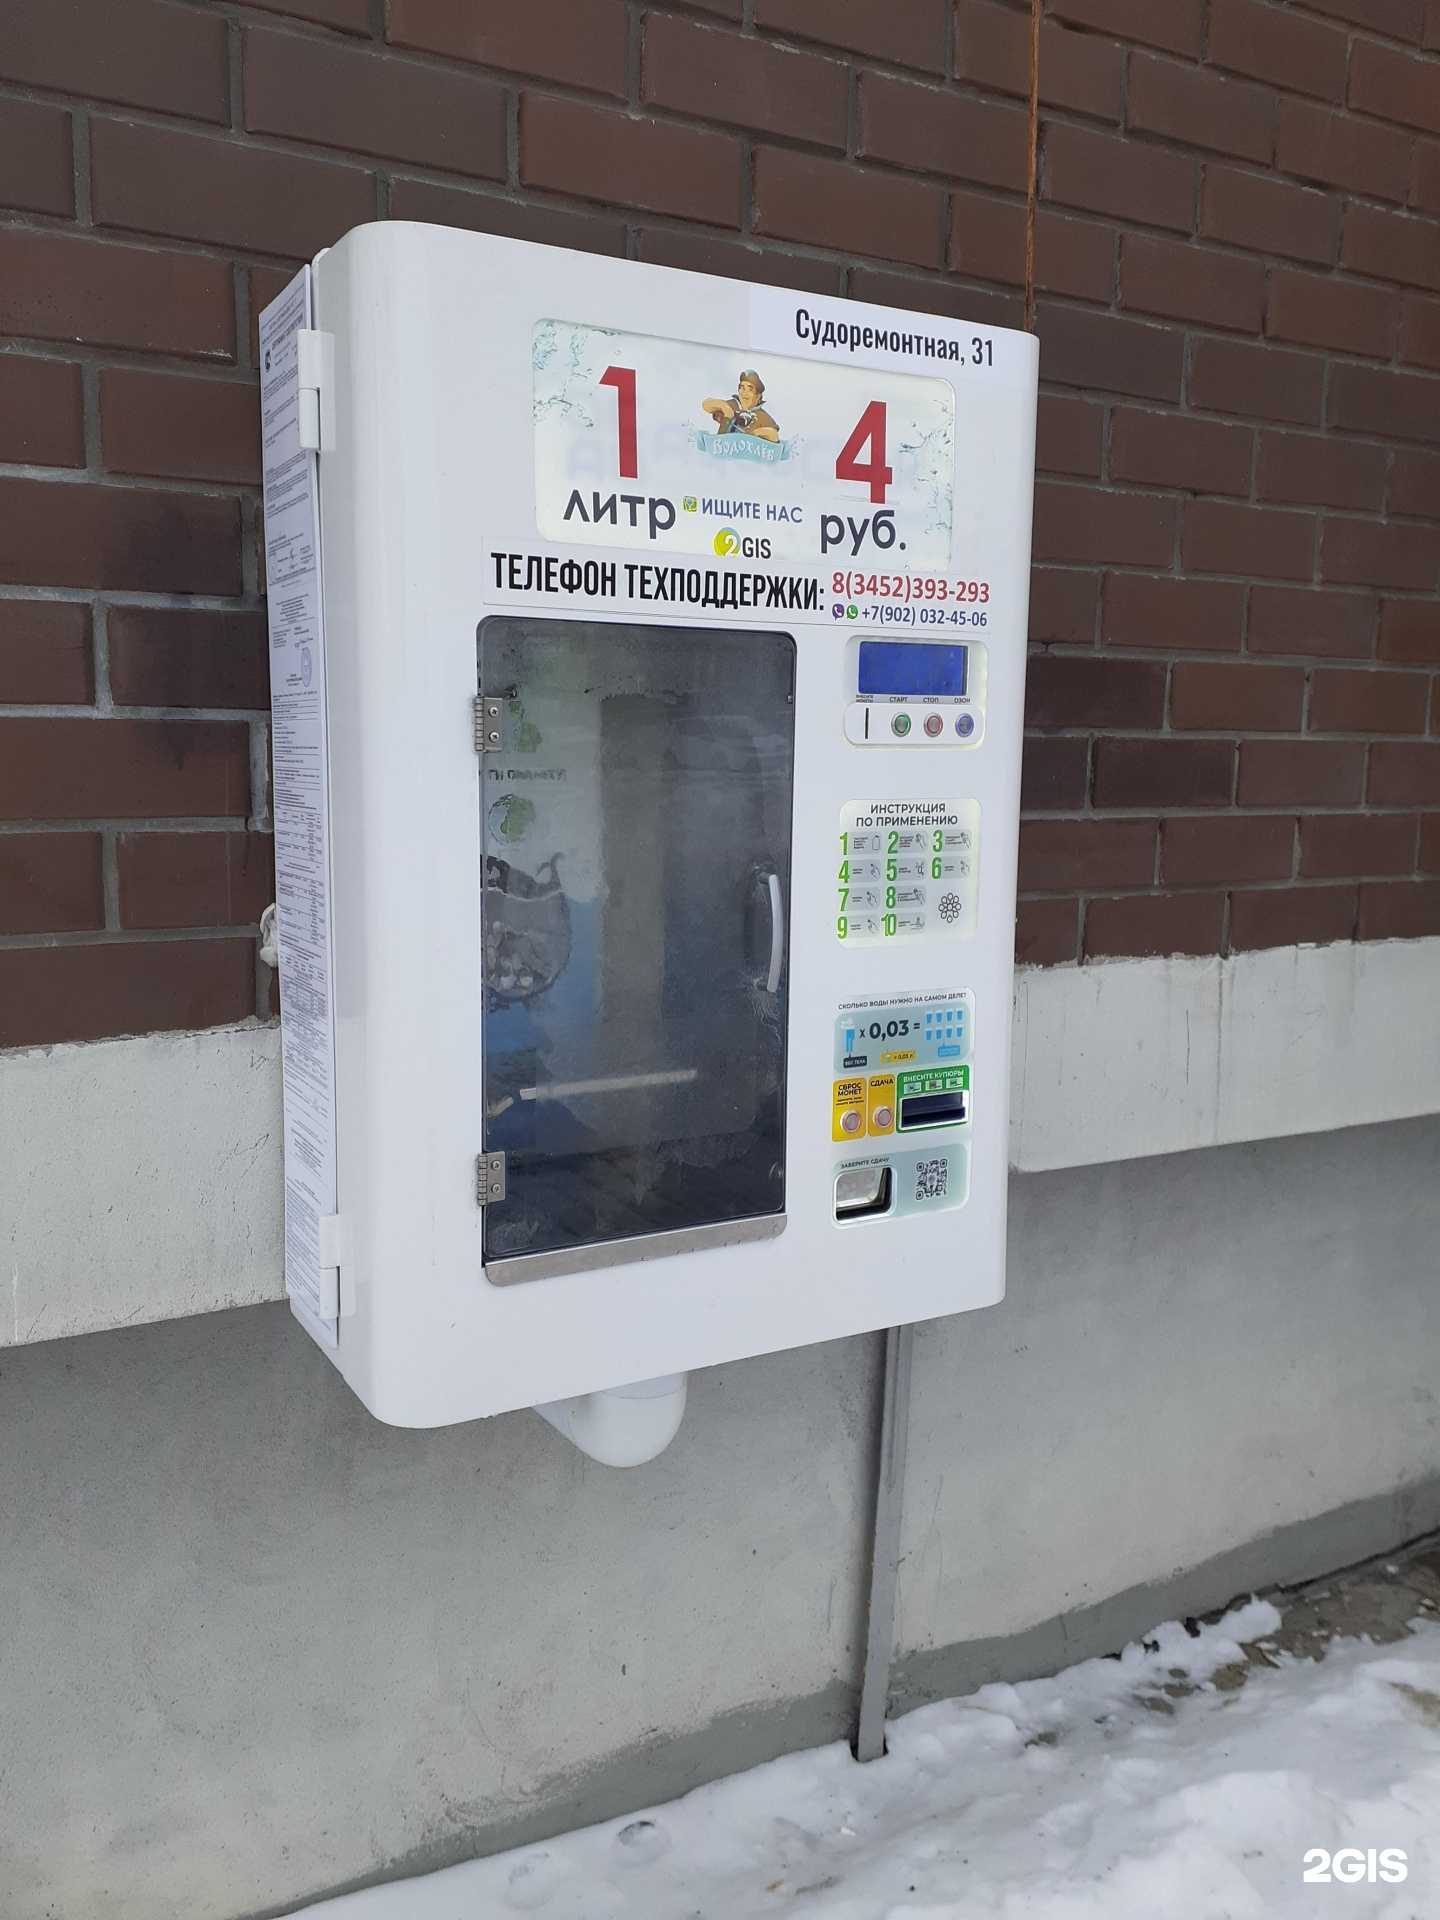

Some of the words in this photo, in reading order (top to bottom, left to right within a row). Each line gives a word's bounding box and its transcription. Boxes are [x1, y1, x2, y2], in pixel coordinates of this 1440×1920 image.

[796, 308, 965, 366] Судоремонтная,
[971, 337, 993, 366] 31
[599, 365, 638, 479] 1
[835, 400, 893, 504] 4
[563, 489, 677, 539] литр
[702, 498, 761, 519] ИЩИТЕ
[766, 504, 803, 523] НАС
[820, 510, 906, 556] руб.
[491, 552, 616, 597] ТЕЛЕФОН
[624, 564, 825, 611] ТЕХПОДДЕРЖКИ:
[832, 571, 990, 603] 8(3452)393-293
[862, 605, 916, 626] +7(902)
[920, 609, 988, 626] 032-45-06
[870, 803, 946, 814] ИНСТРУКЦИЯ
[856, 817, 873, 827] ПО
[876, 815, 958, 827] ПРИМЕНЕНИЮ
[840, 832, 848, 855] 1
[887, 831, 899, 854] 2
[932, 830, 943, 852] 3
[838, 860, 849, 883] 4
[886, 859, 897, 881] 5
[931, 857, 941, 880] 6
[838, 888, 849, 911] 7
[885, 886, 896, 909] 8
[837, 916, 848, 939] 9
[881, 913, 896, 936] 10
[838, 1002, 868, 1010] СКОЛЬКО
[869, 1019, 909, 1041] 0,03
[838, 1082, 862, 1090] СБРОС
[870, 1078, 894, 1087] СДАЧА
[903, 1073, 932, 1082] ВНЕСИТЕ
[934, 1070, 965, 1079] КУПЮРЫ
[837, 1088, 862, 1097] МОНЕТ
[841, 1160, 869, 1168] ЗАБЕРИТЕ
